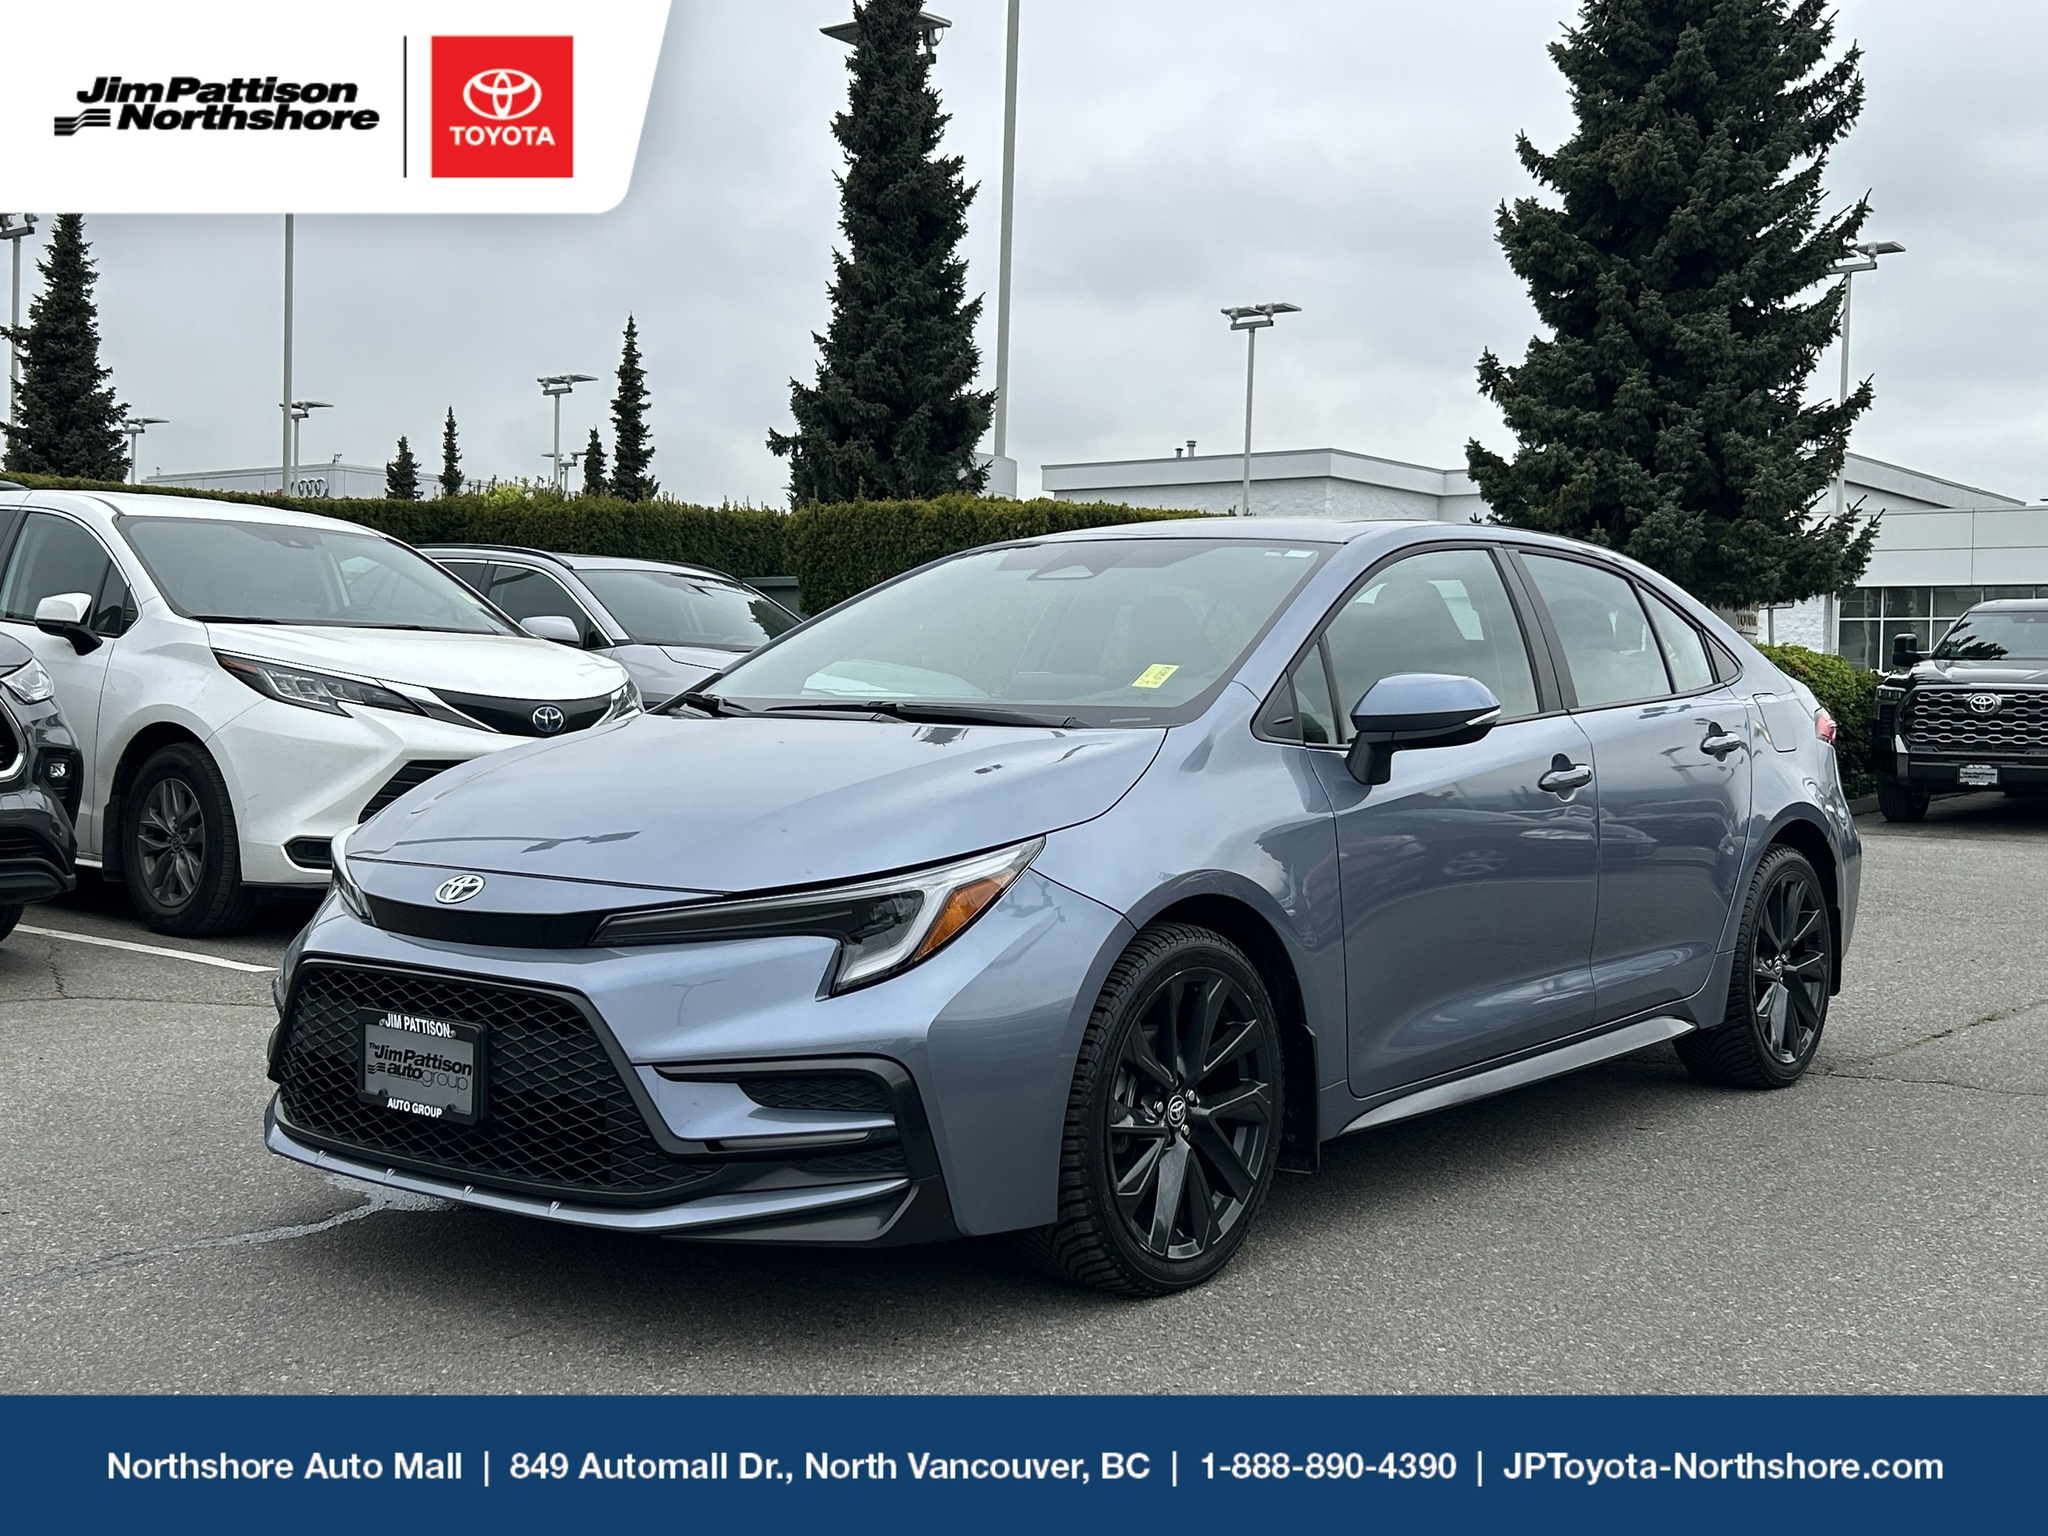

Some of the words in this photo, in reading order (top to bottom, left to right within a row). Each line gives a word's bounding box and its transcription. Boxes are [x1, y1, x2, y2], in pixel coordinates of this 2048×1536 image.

[385, 1013, 402, 1029] JIM
[404, 1015, 452, 1039] PATTISON
[368, 1042, 381, 1051] The
[387, 1098, 411, 1112] AUTO
[411, 1102, 443, 1119] GROUP
